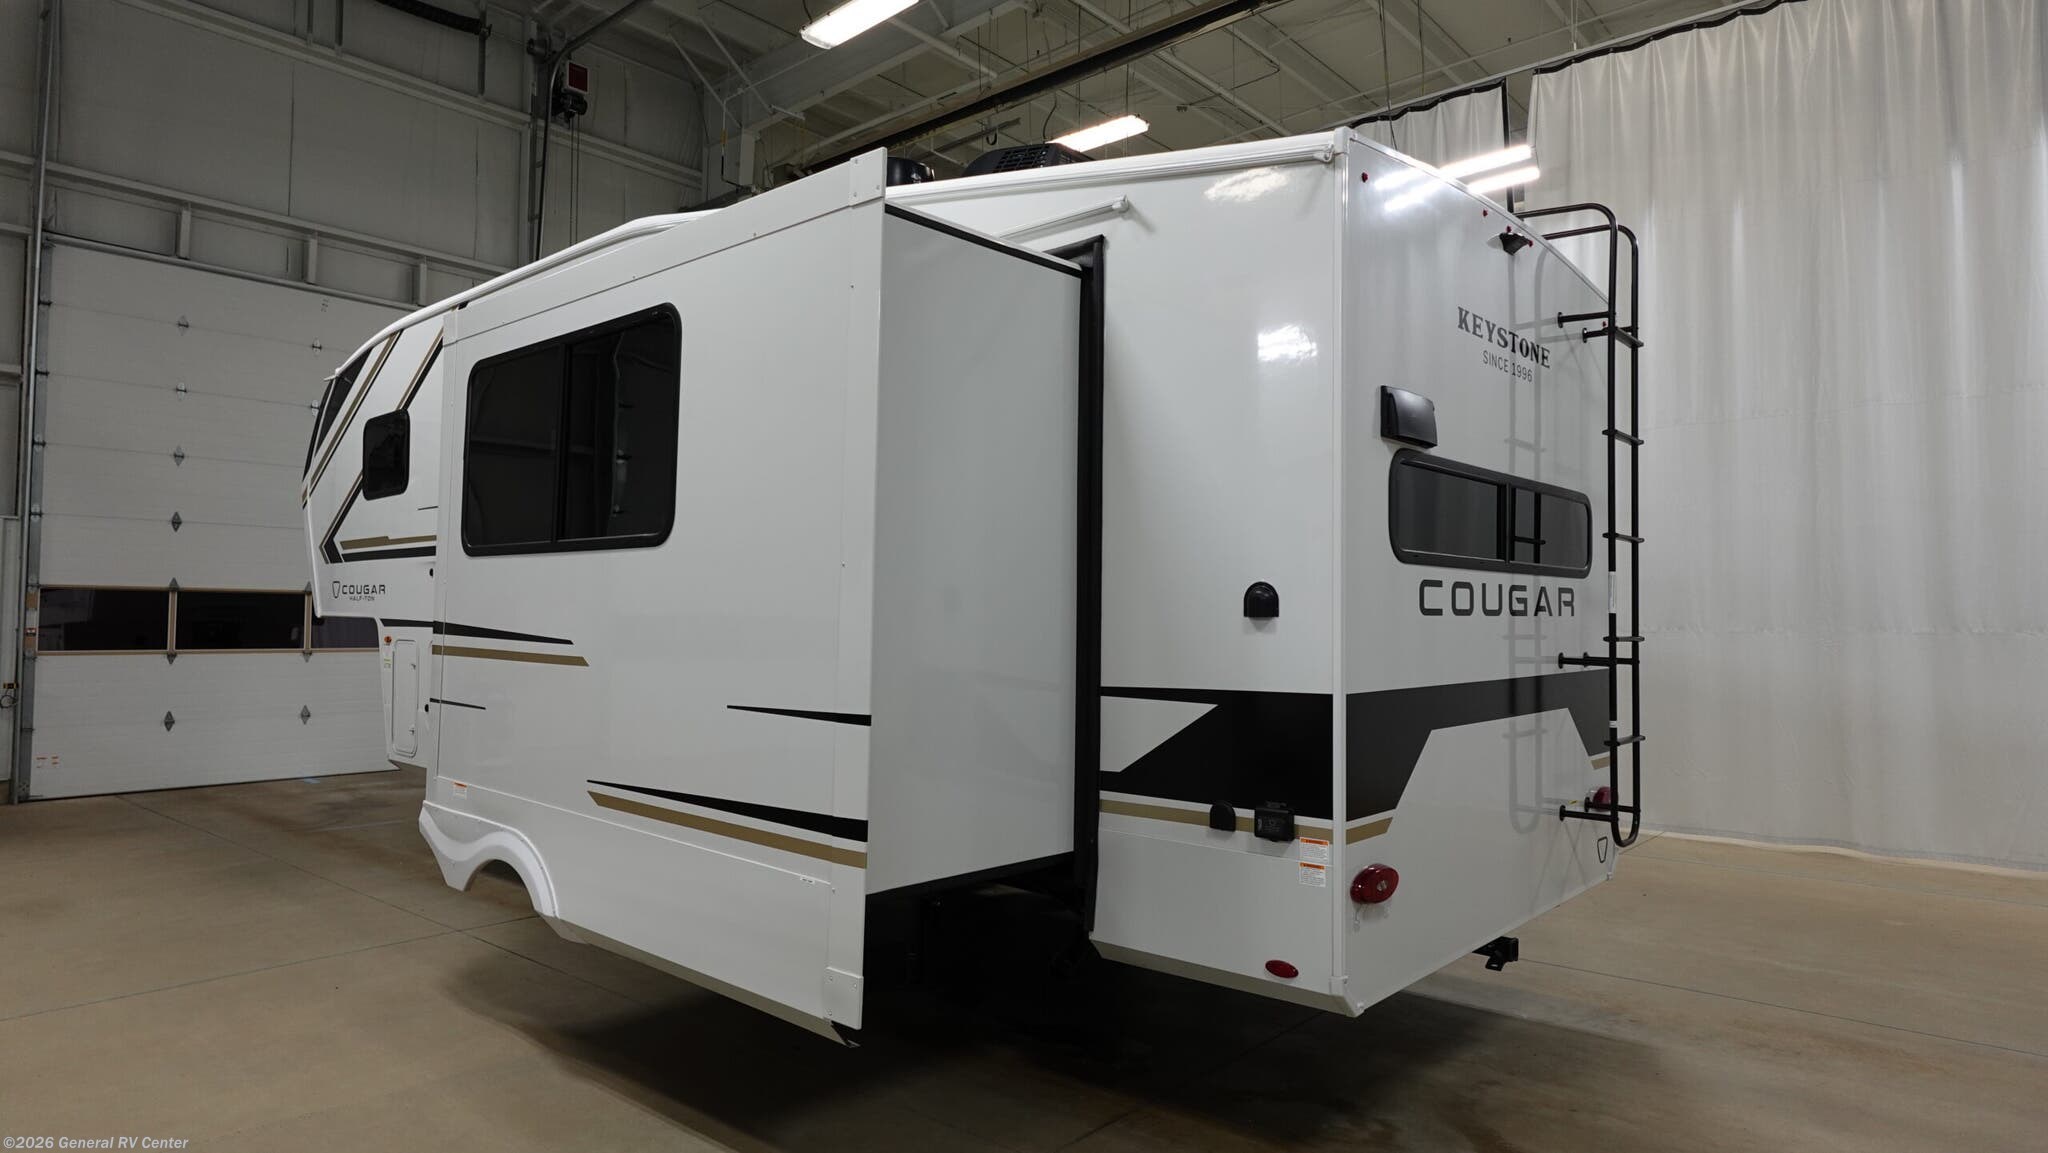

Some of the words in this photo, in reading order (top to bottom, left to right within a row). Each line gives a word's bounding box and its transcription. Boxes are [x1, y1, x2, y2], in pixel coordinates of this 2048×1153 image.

[1457, 305, 1551, 369] KEYSTONE
[1482, 349, 1509, 373] SINCE
[1511, 362, 1533, 383] 1996
[341, 584, 386, 595] COUGAR
[1419, 579, 1575, 617] COUGAR
